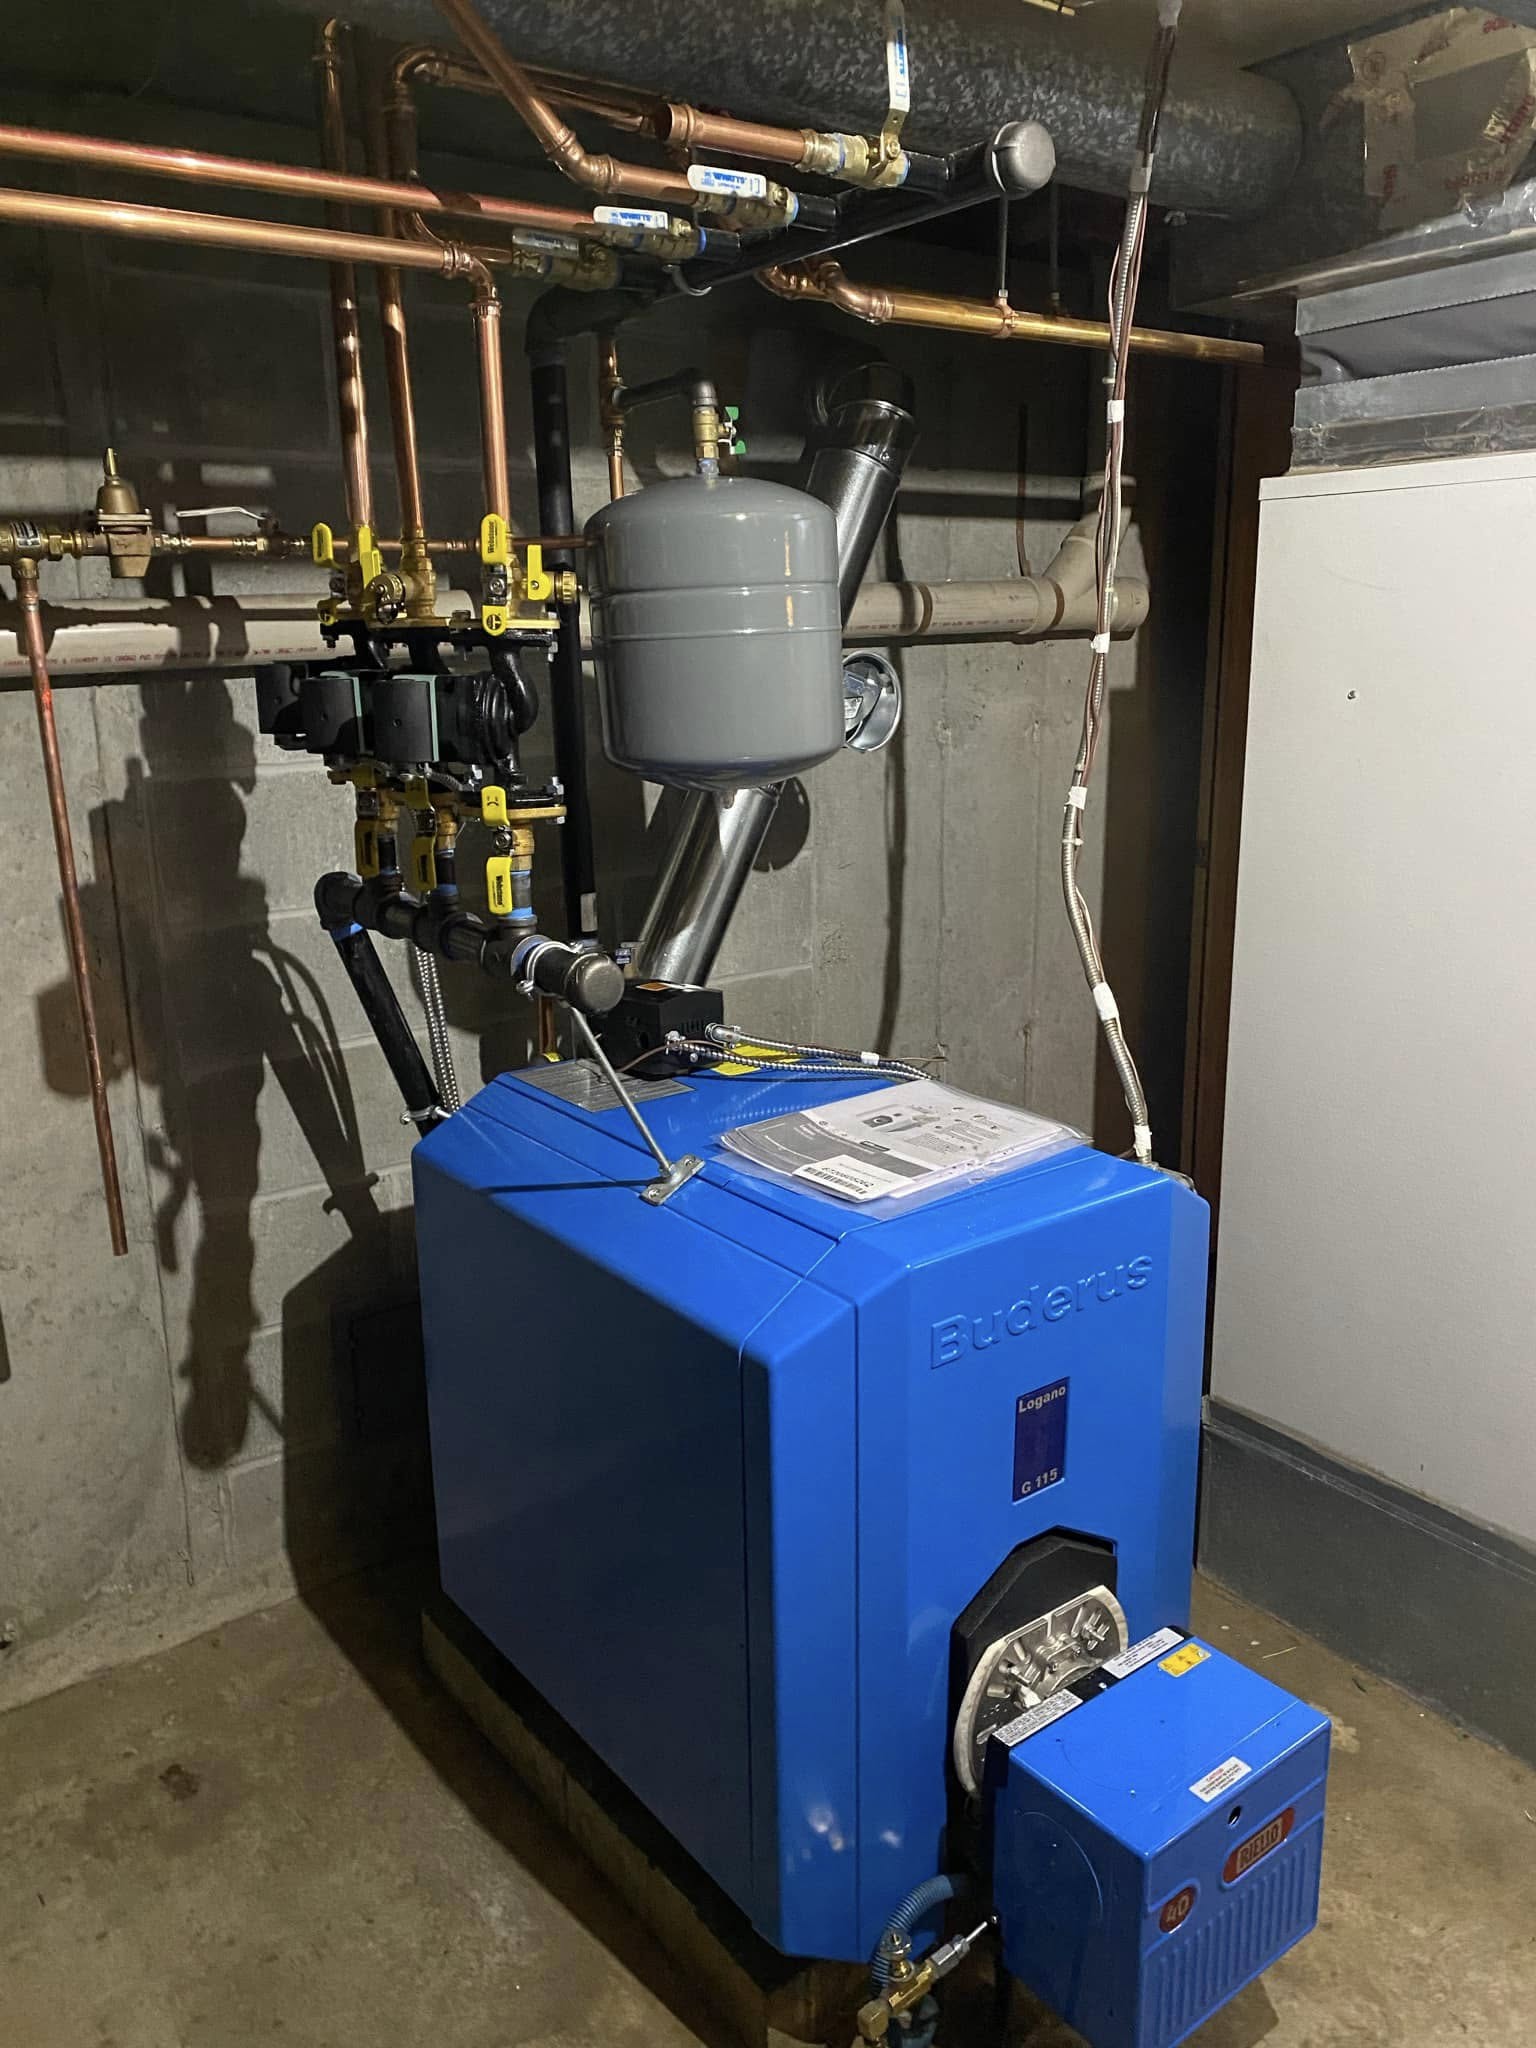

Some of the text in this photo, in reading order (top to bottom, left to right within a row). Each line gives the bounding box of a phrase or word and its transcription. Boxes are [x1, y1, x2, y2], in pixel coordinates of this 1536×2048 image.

[930, 1254, 1153, 1370] Buderus
[1018, 1385, 1067, 1413] Logano
[1021, 1468, 1058, 1495] G 115
[1238, 1822, 1280, 1869] RIELLO
[1166, 1894, 1190, 1923] 40
